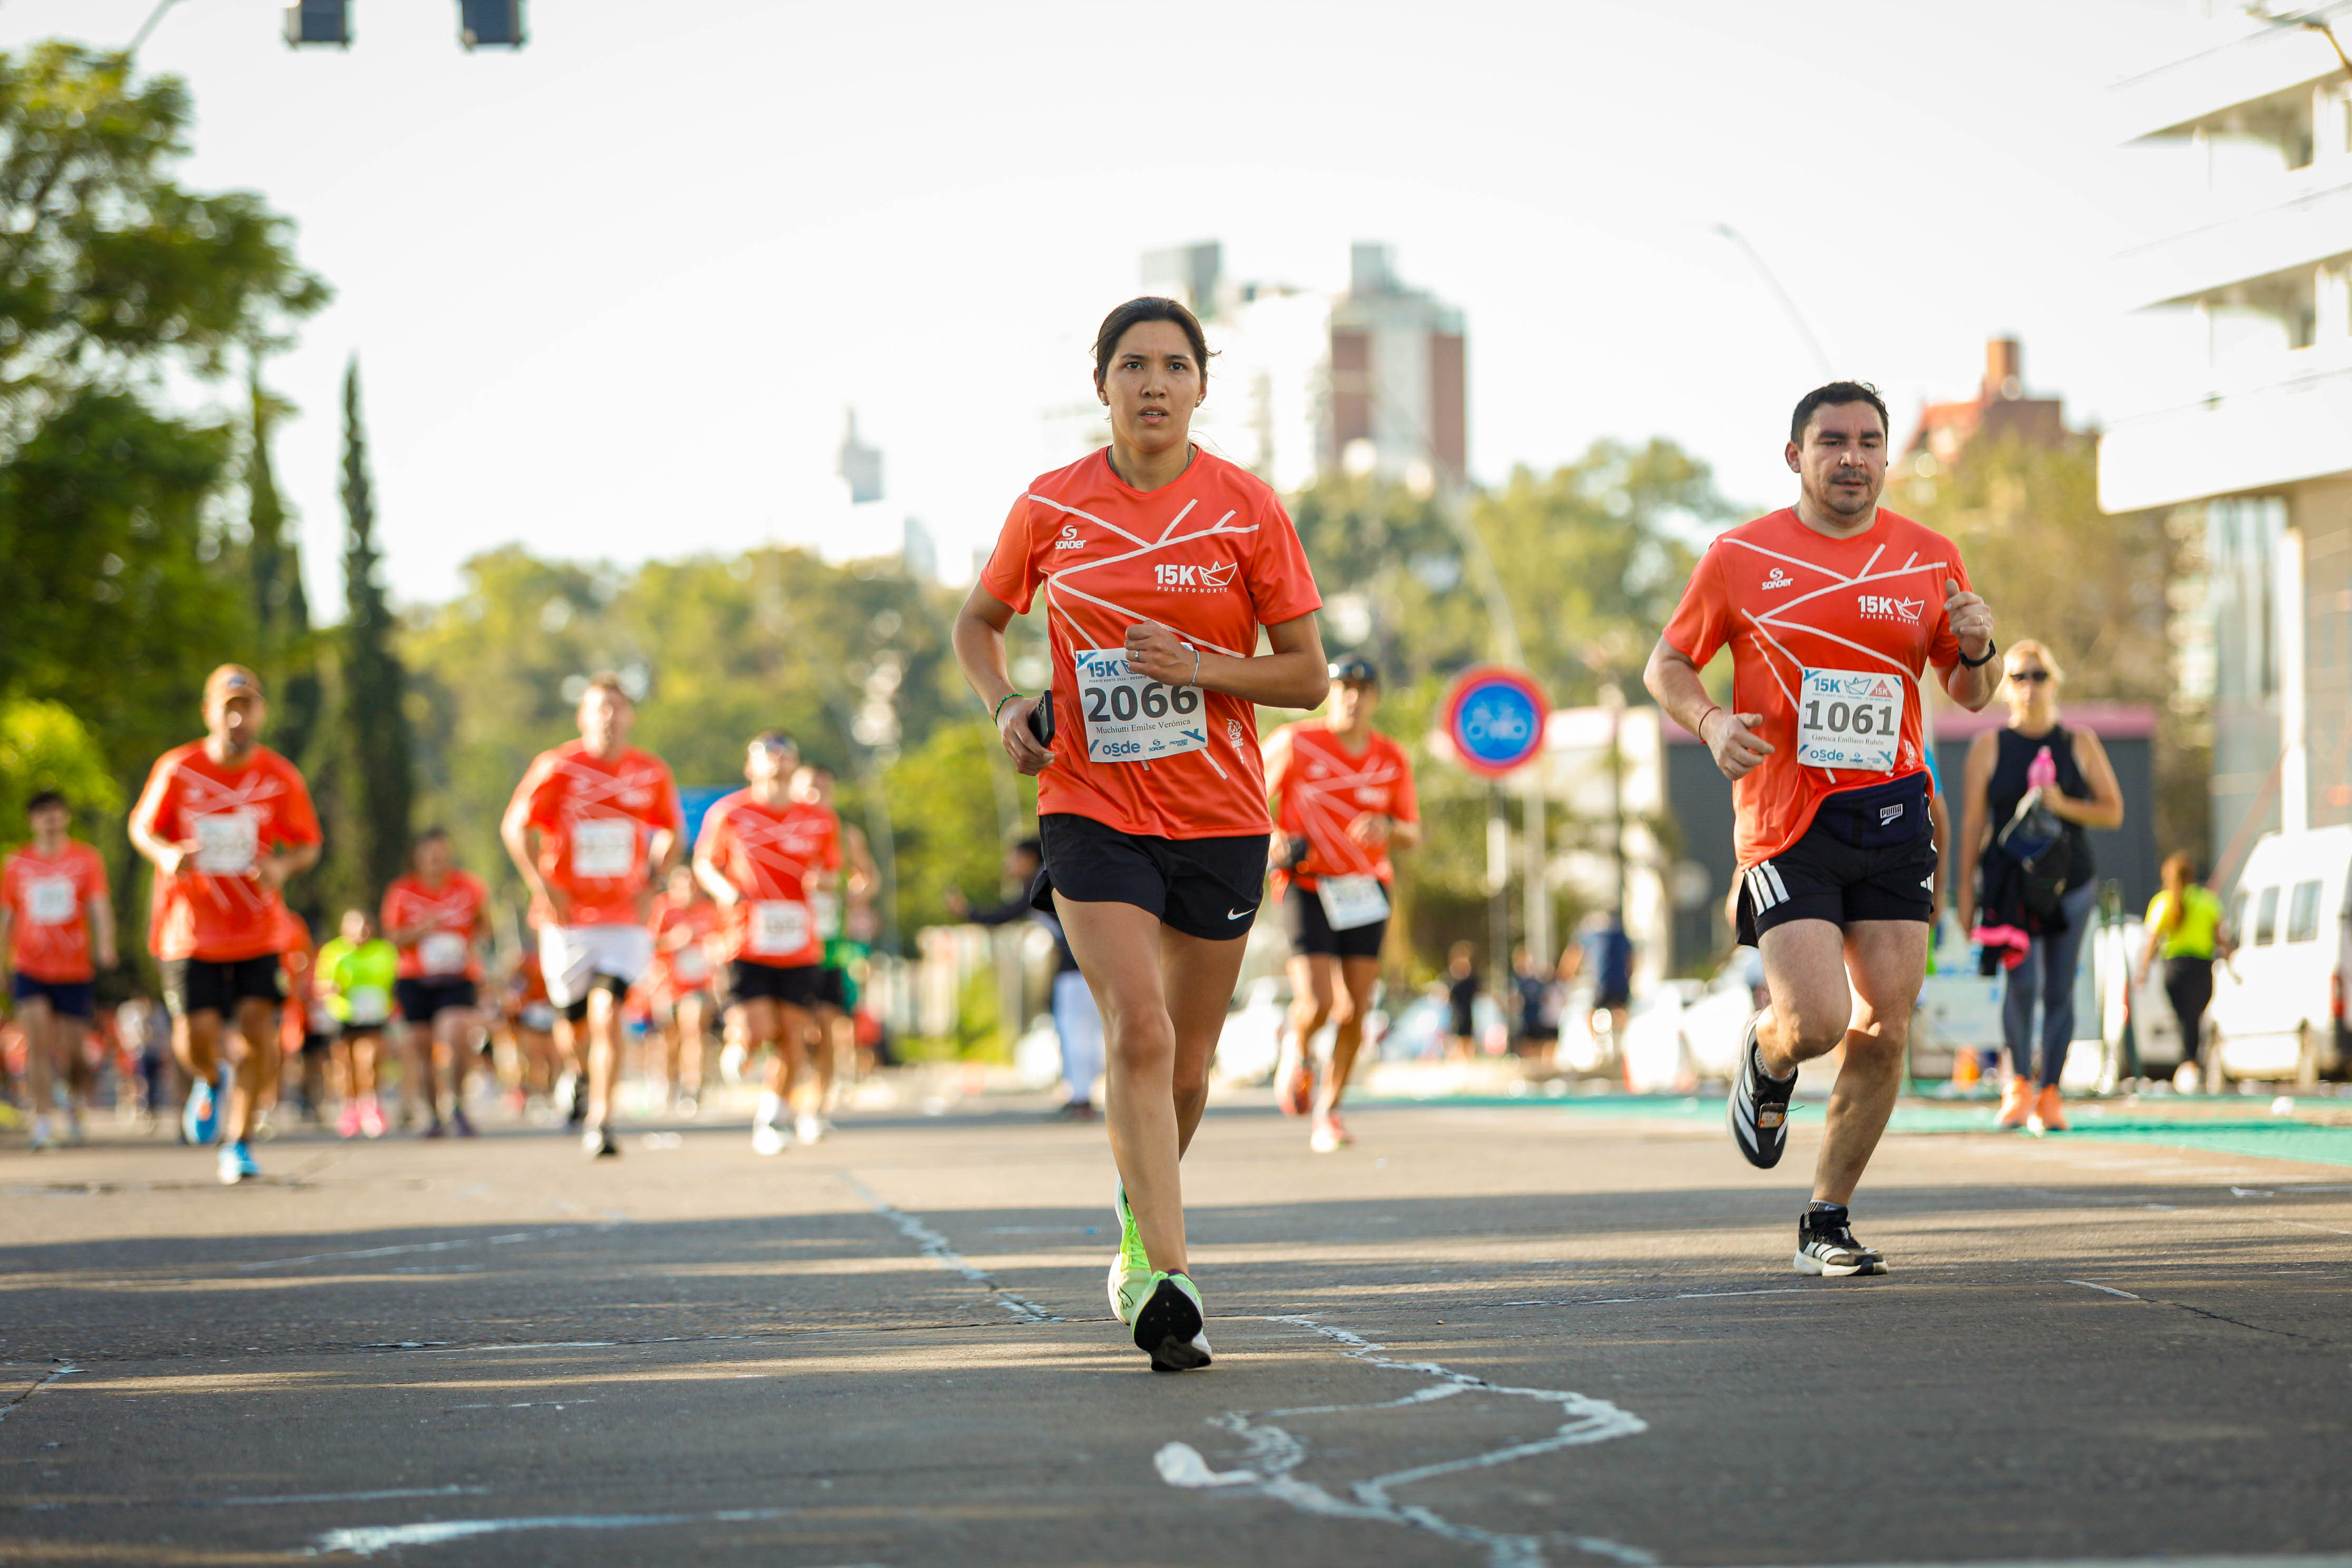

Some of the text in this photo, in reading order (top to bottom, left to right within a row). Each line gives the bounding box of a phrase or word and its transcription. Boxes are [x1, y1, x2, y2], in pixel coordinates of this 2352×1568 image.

[1154, 564, 1197, 586] 15K
[1858, 595, 1894, 615] 15K
[1860, 613, 1919, 626] PUERTO NORTE
[1087, 660, 1120, 678] 15K
[1814, 678, 1841, 693] 15K
[1875, 687, 1888, 696] 15K
[1084, 682, 1198, 722] 2066
[1804, 699, 1895, 736] 1061
[1096, 719, 1191, 734] Muchiutti Emilse Verónica
[1812, 733, 1884, 746] Garnica Emiliano Rubén
[1102, 740, 1141, 757] osde
[1810, 749, 1844, 761] osde
